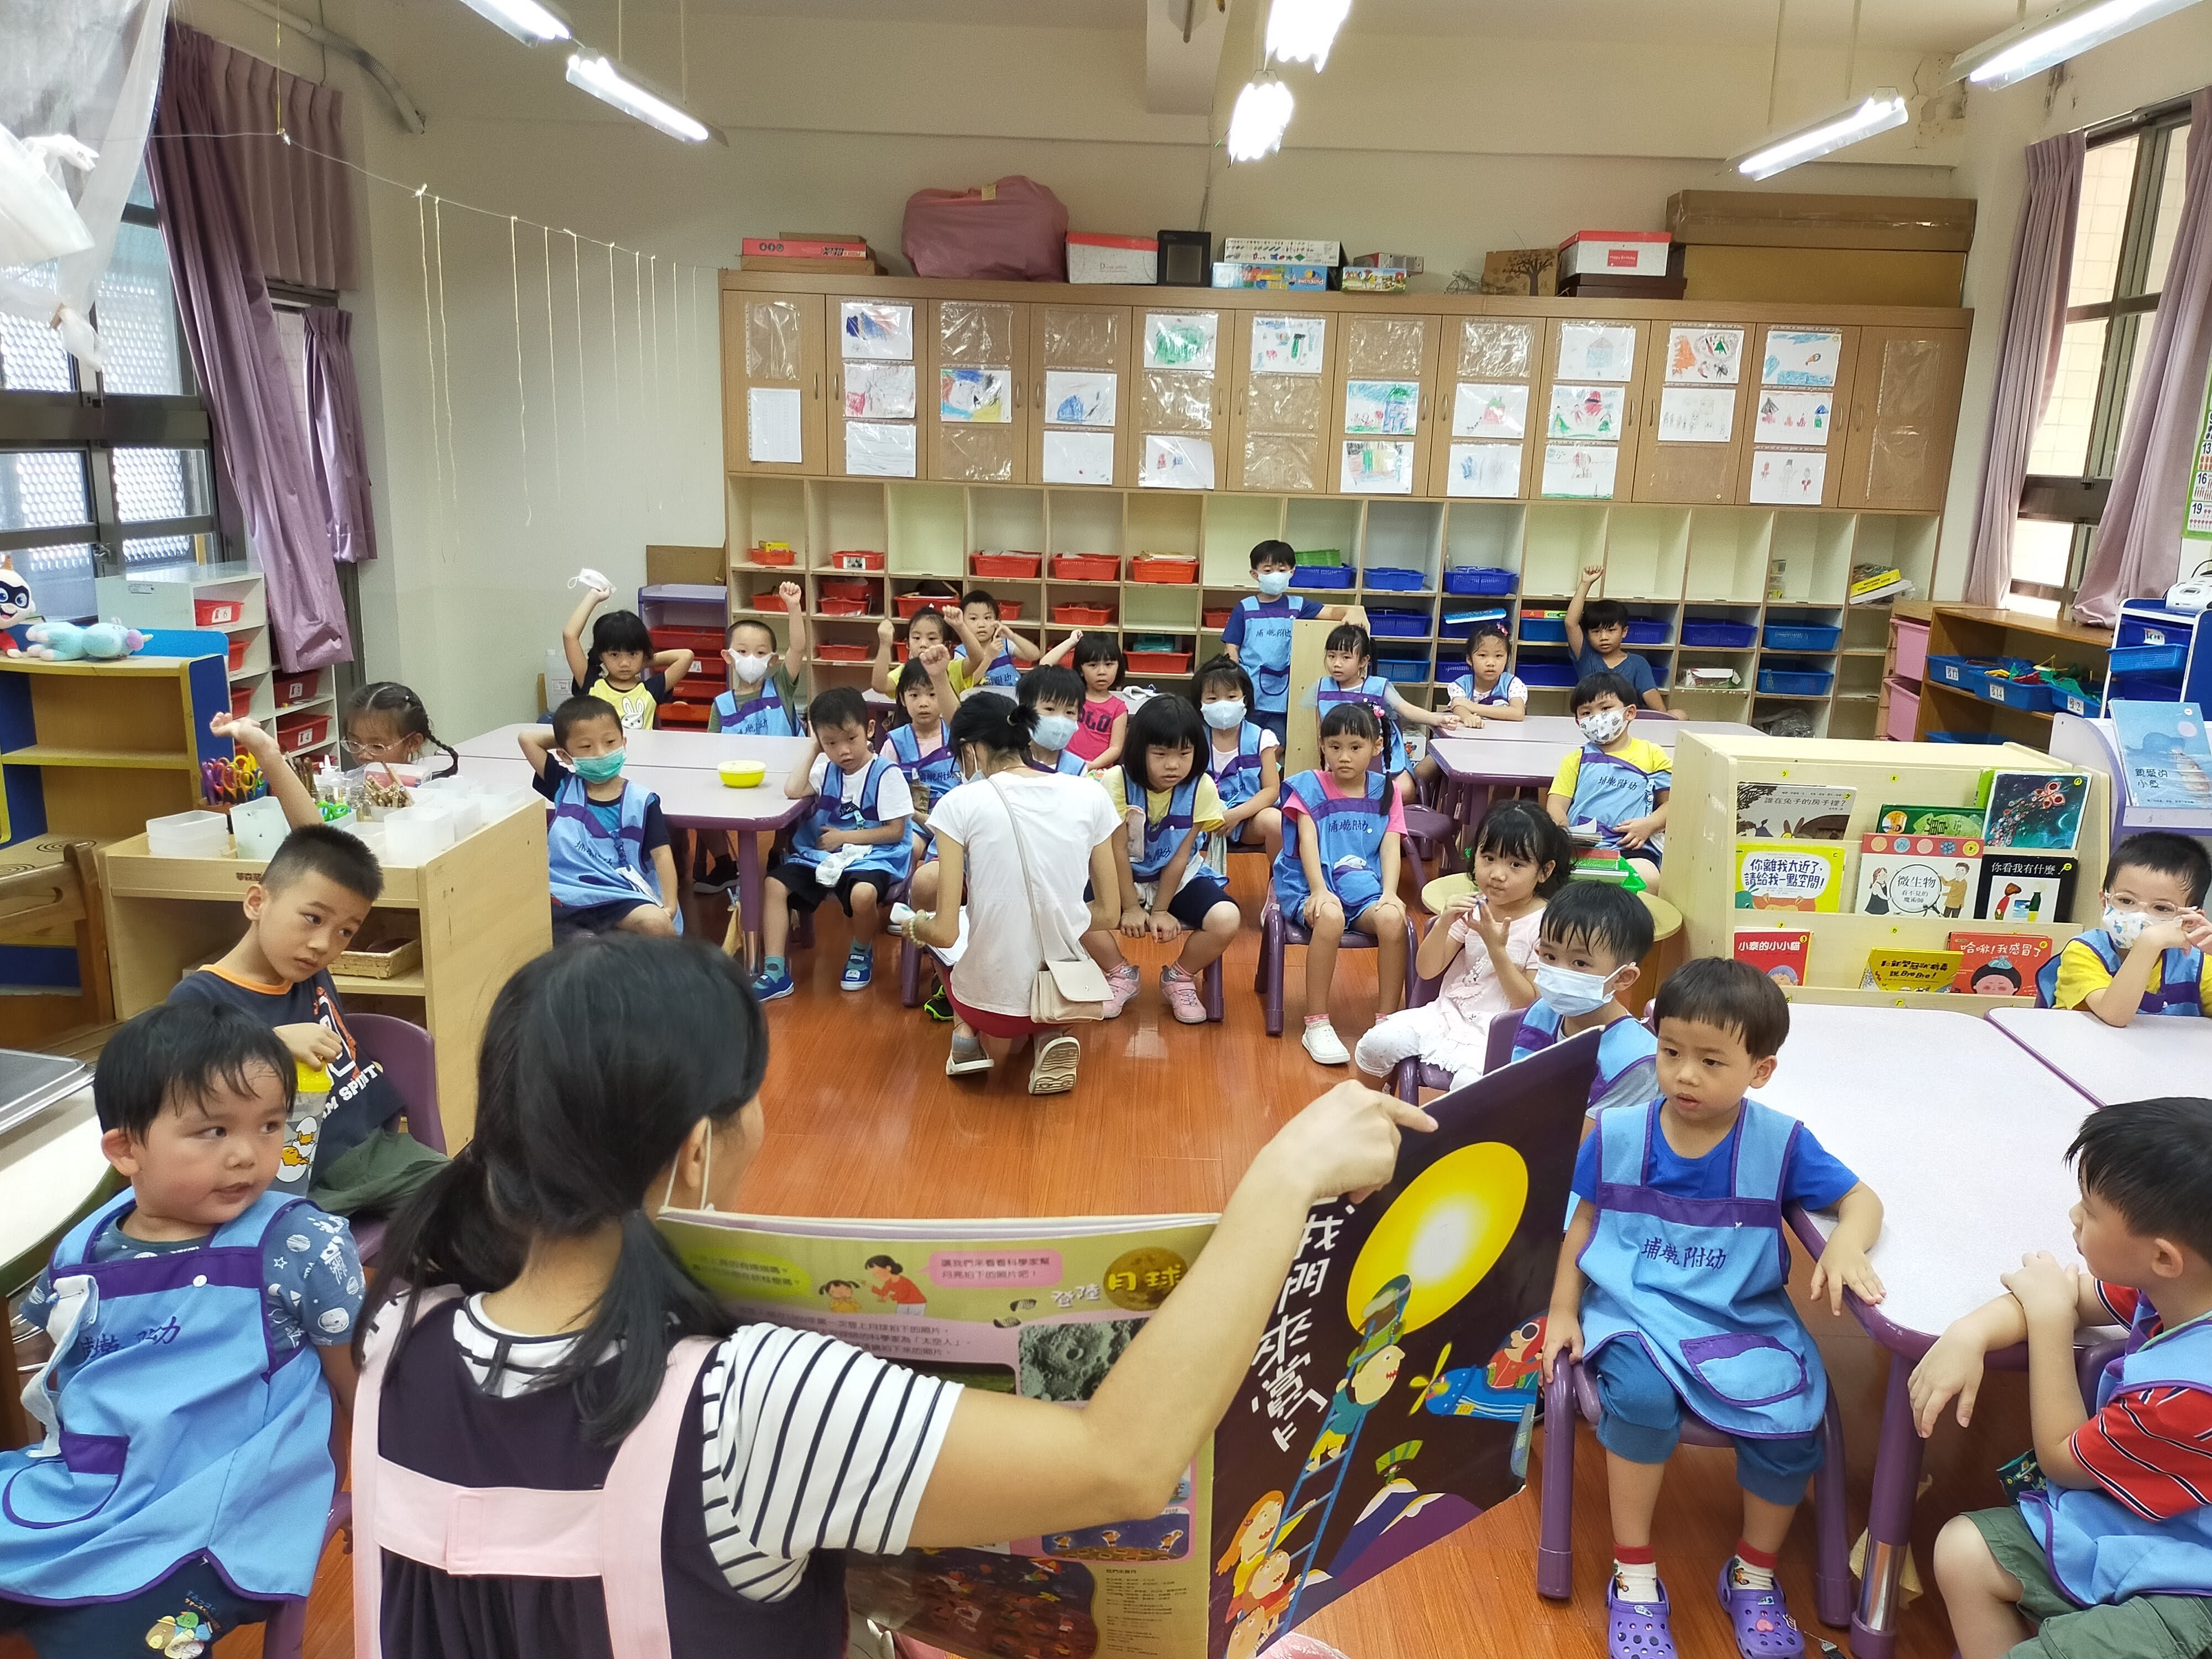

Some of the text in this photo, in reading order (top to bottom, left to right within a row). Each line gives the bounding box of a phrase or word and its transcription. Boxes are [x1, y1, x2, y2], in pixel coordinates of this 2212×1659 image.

[2202, 442, 2211, 454] 13
[2197, 473, 2207, 484] 16
[2192, 503, 2203, 514] 19
[223, 610, 228, 618] 6
[1744, 872, 1825, 889] 請給我一點空間!
[1897, 875, 1937, 889] 微生物
[1960, 941, 2042, 958] 哈啾!我感冒了
[1641, 1237, 1726, 1270] 埔墘附幼
[1052, 1263, 1182, 1308] 登陸 月球
